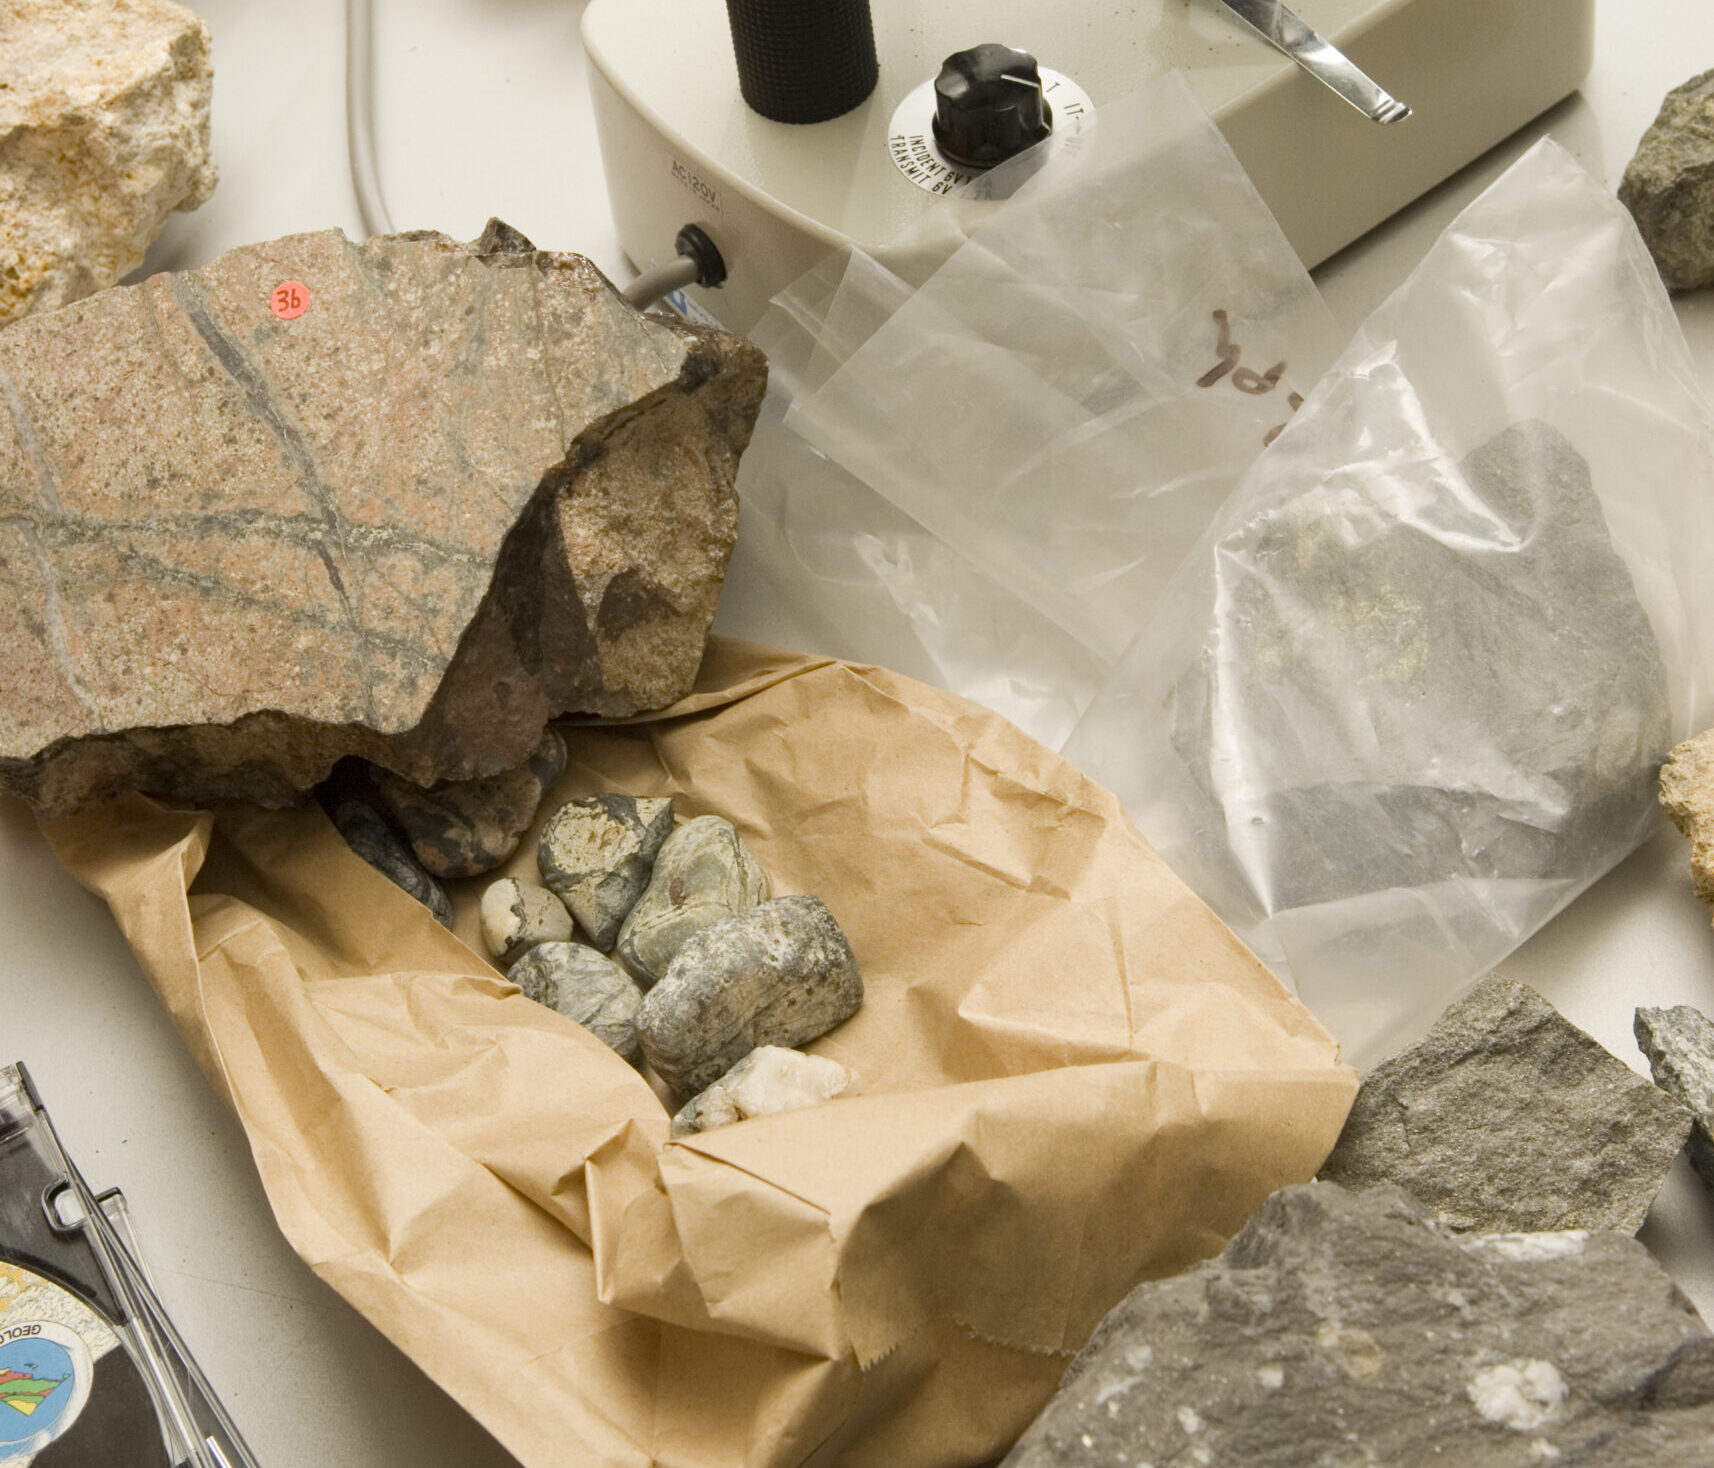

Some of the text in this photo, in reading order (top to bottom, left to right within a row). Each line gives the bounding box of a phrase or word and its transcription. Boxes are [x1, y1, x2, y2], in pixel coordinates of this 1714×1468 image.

[889, 134, 931, 185] TRANSMIT
[931, 181, 953, 195] 6V
[908, 134, 964, 184] INCIDENT 6V
